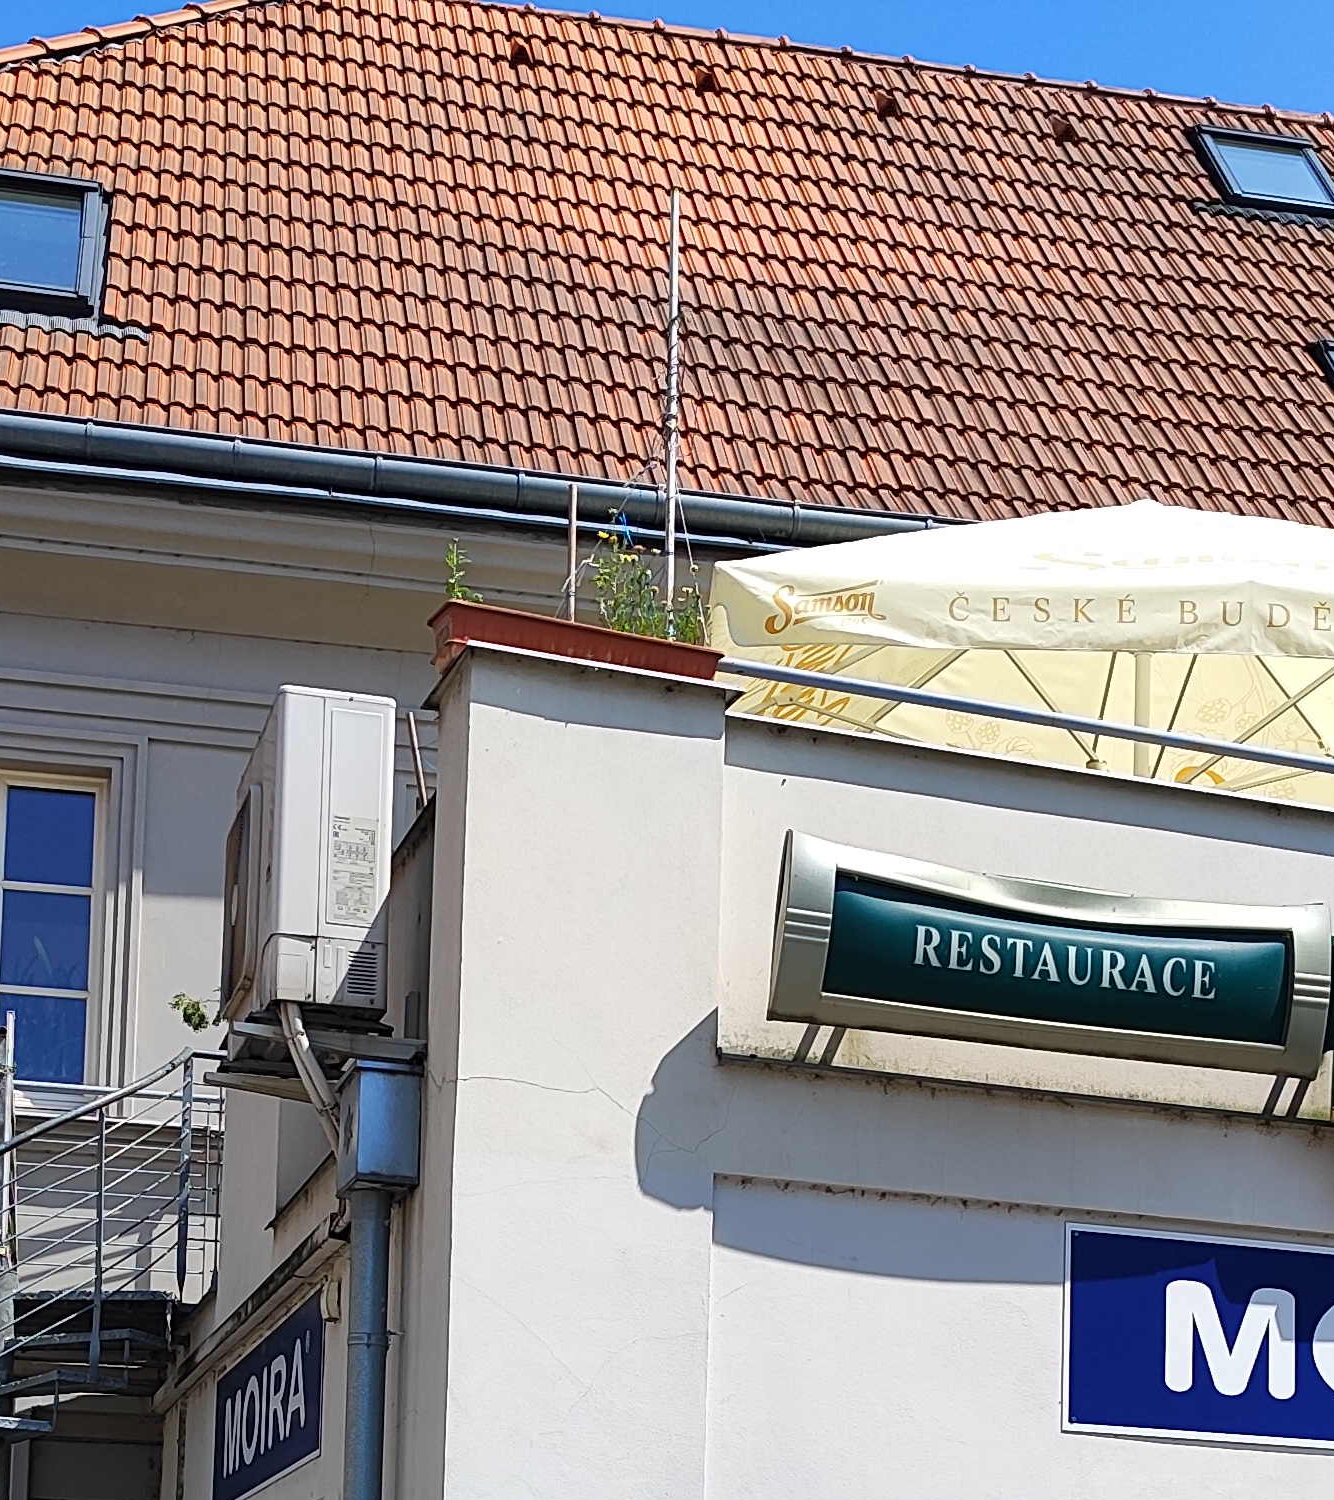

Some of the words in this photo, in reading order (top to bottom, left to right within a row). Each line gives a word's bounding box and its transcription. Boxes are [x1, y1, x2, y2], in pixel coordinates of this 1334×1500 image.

[764, 584, 887, 634] Samson
[948, 591, 1137, 624] ČESKÉ
[913, 924, 1217, 1000] RESTAURACE
[223, 1337, 306, 1480] MOIRA
